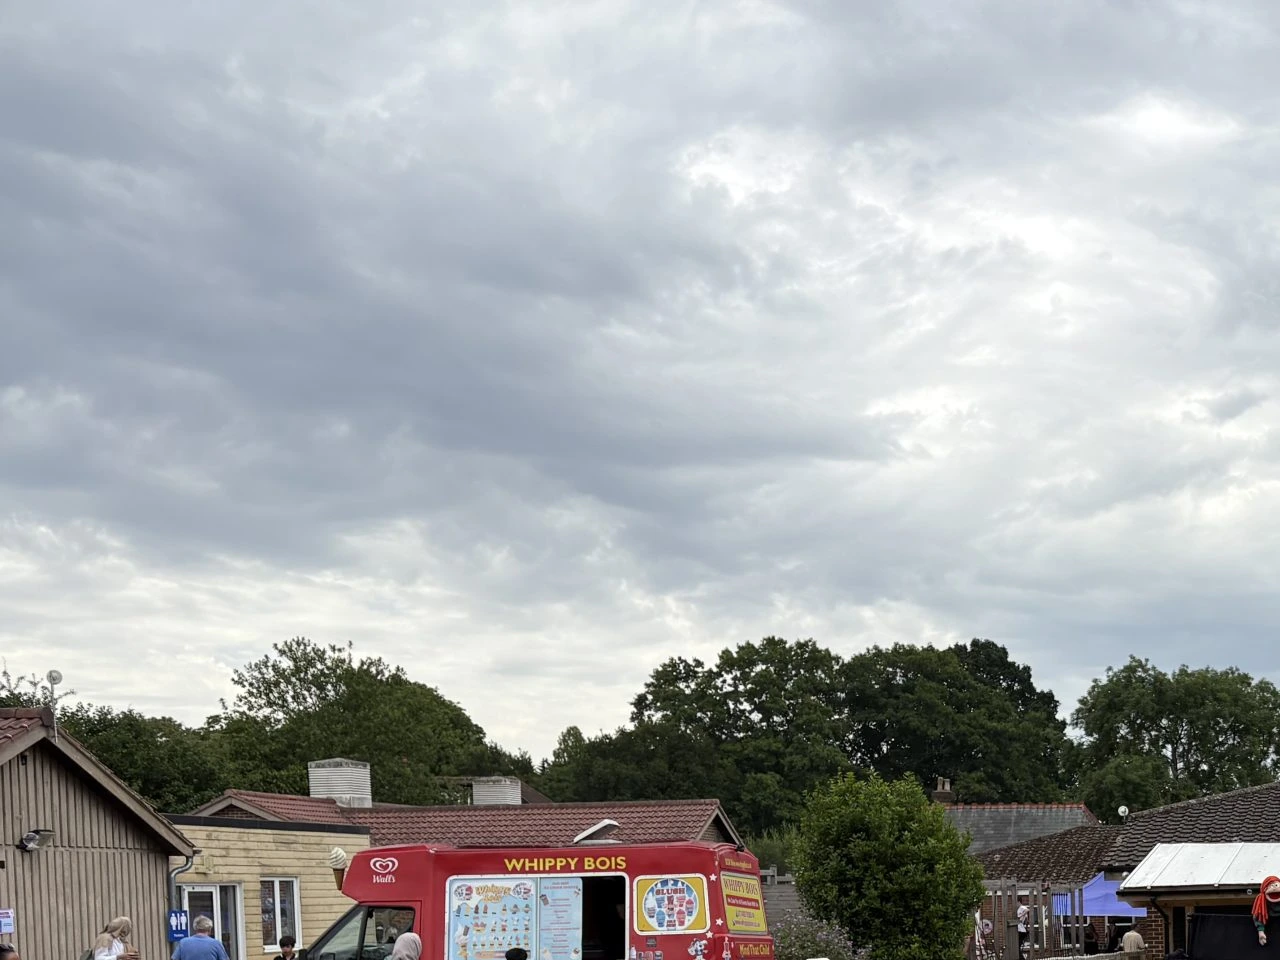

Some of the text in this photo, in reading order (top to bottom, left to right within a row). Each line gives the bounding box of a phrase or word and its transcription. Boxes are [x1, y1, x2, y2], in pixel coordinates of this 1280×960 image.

[504, 856, 626, 871] WHIPPY BOIS
[655, 887, 686, 896] SLUSH
